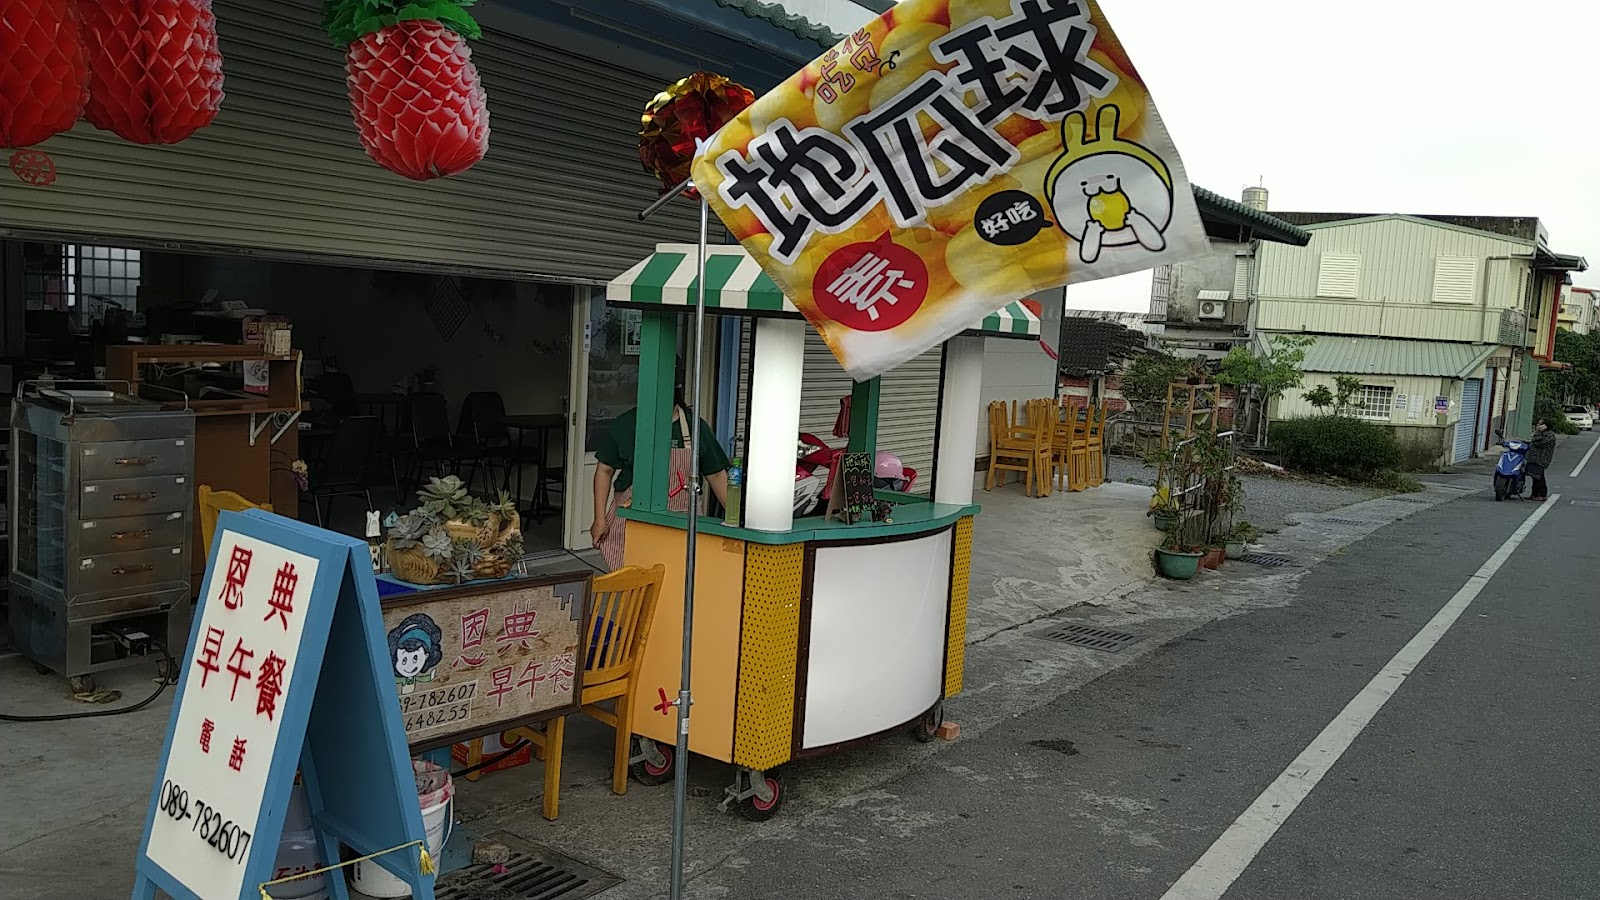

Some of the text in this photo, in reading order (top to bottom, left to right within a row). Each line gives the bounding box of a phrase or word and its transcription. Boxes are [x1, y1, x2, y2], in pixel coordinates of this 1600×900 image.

[718, 0, 1112, 261] 地瓜球
[980, 200, 1038, 239] 好吃
[826, 250, 915, 322] 素
[219, 544, 298, 631] 恩典
[453, 599, 540, 668] 恩典
[197, 624, 287, 722] 早午餐
[399, 683, 476, 713] 9-782607
[486, 654, 575, 708] 早午餐
[199, 718, 248, 772] 電話
[160, 779, 251, 866] 089-782607
